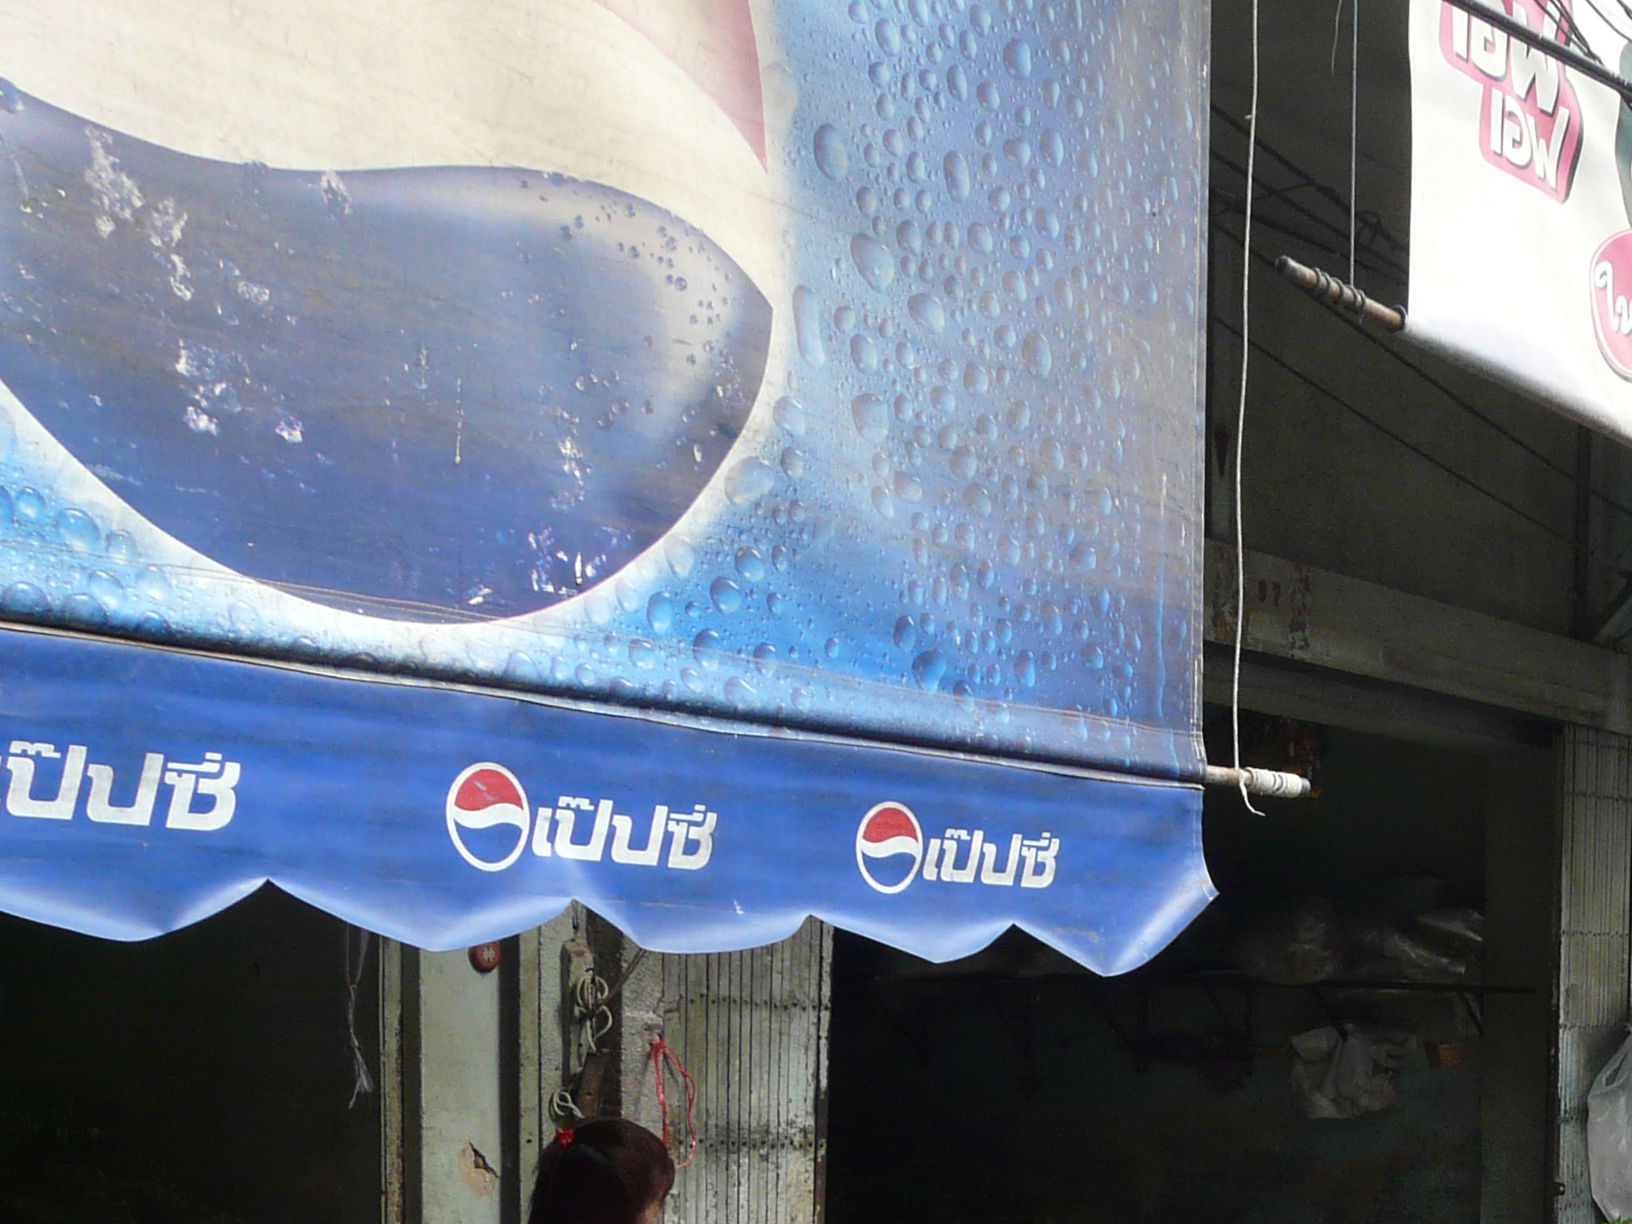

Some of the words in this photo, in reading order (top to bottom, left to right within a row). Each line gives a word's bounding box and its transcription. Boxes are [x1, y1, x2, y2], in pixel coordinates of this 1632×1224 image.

[0, 739, 242, 832] ป๊ปซี่
[531, 795, 719, 871] เป๊ปซี่
[922, 827, 1061, 889] เป๊ปซี่
